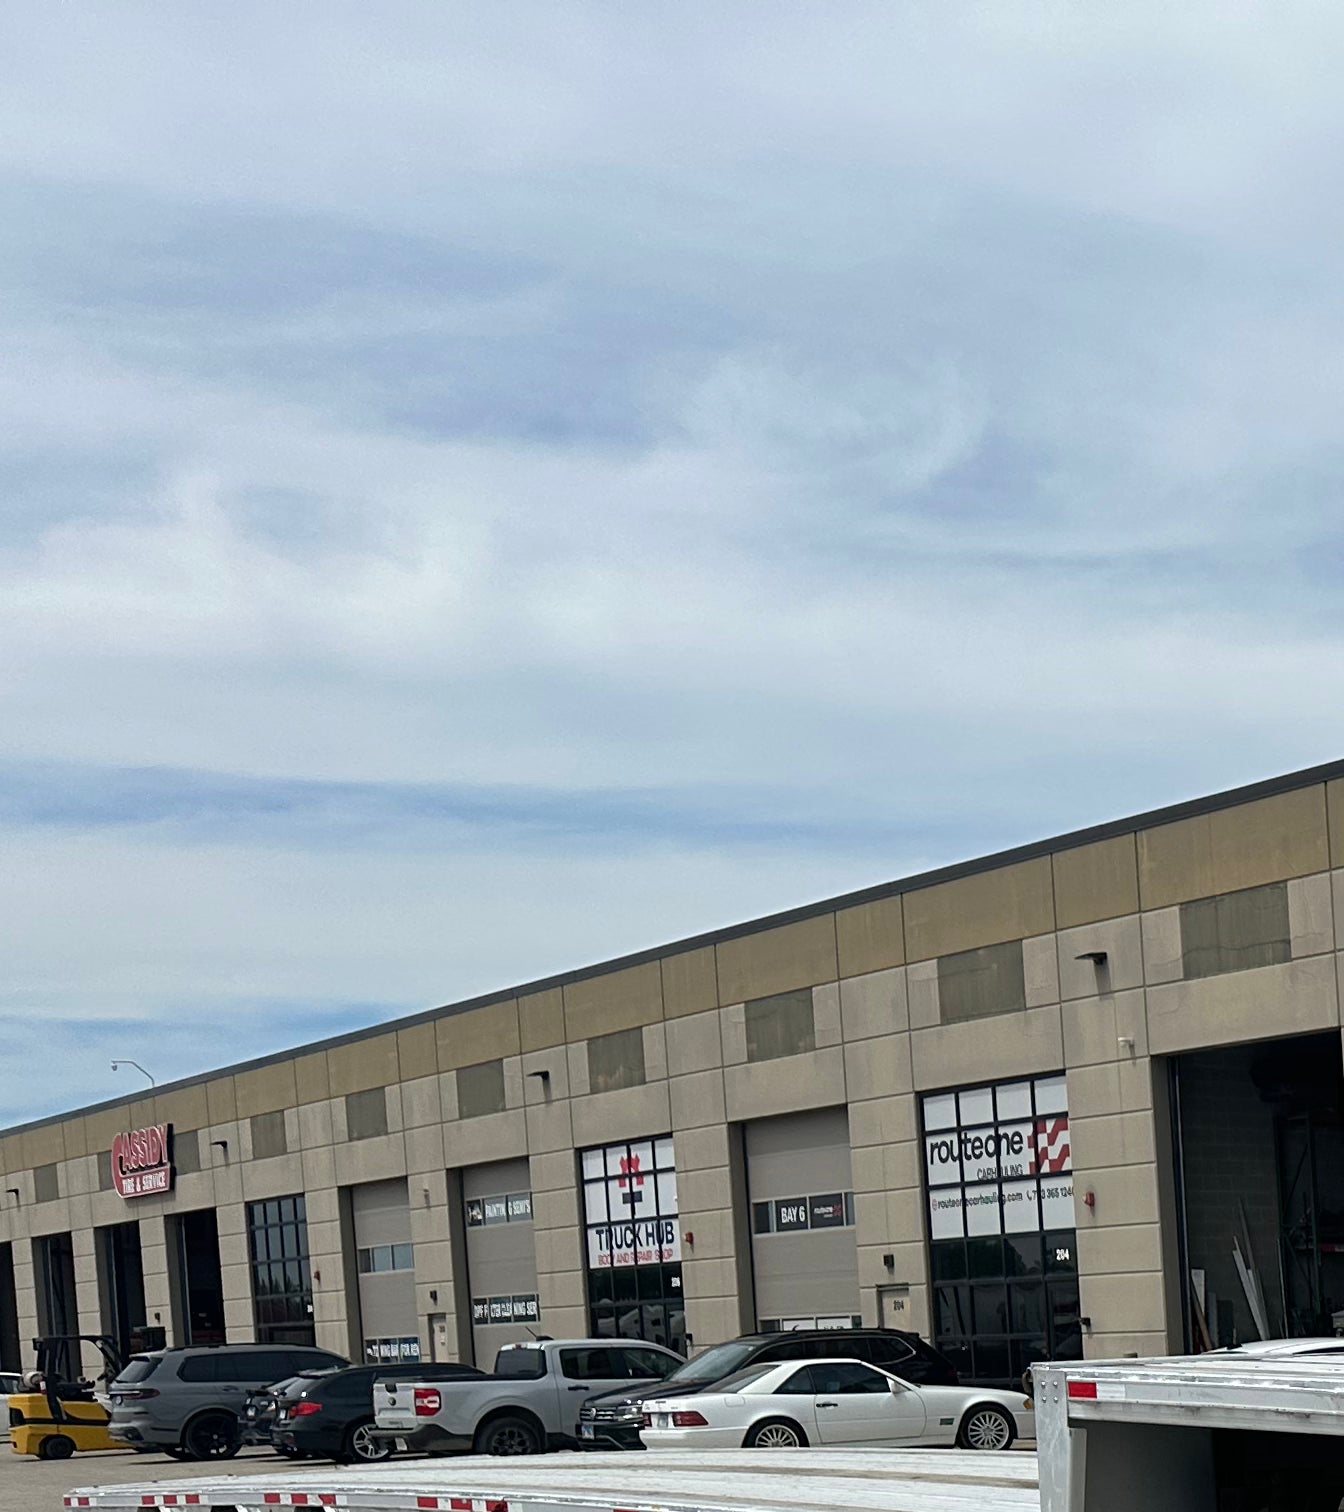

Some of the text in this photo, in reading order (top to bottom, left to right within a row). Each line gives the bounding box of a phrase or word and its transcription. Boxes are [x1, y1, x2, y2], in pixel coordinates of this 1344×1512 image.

[111, 1123, 168, 1176] CASSIDY
[930, 1130, 1024, 1165] routeone
[976, 1163, 1024, 1180] CARHULING
[781, 1206, 798, 1223] BAY
[799, 1205, 806, 1222] 6
[595, 1221, 675, 1252] TRUCK HUB
[631, 1250, 653, 1263] RPAIR
[655, 1248, 674, 1261] SOP
[1056, 1249, 1070, 1261] 204
